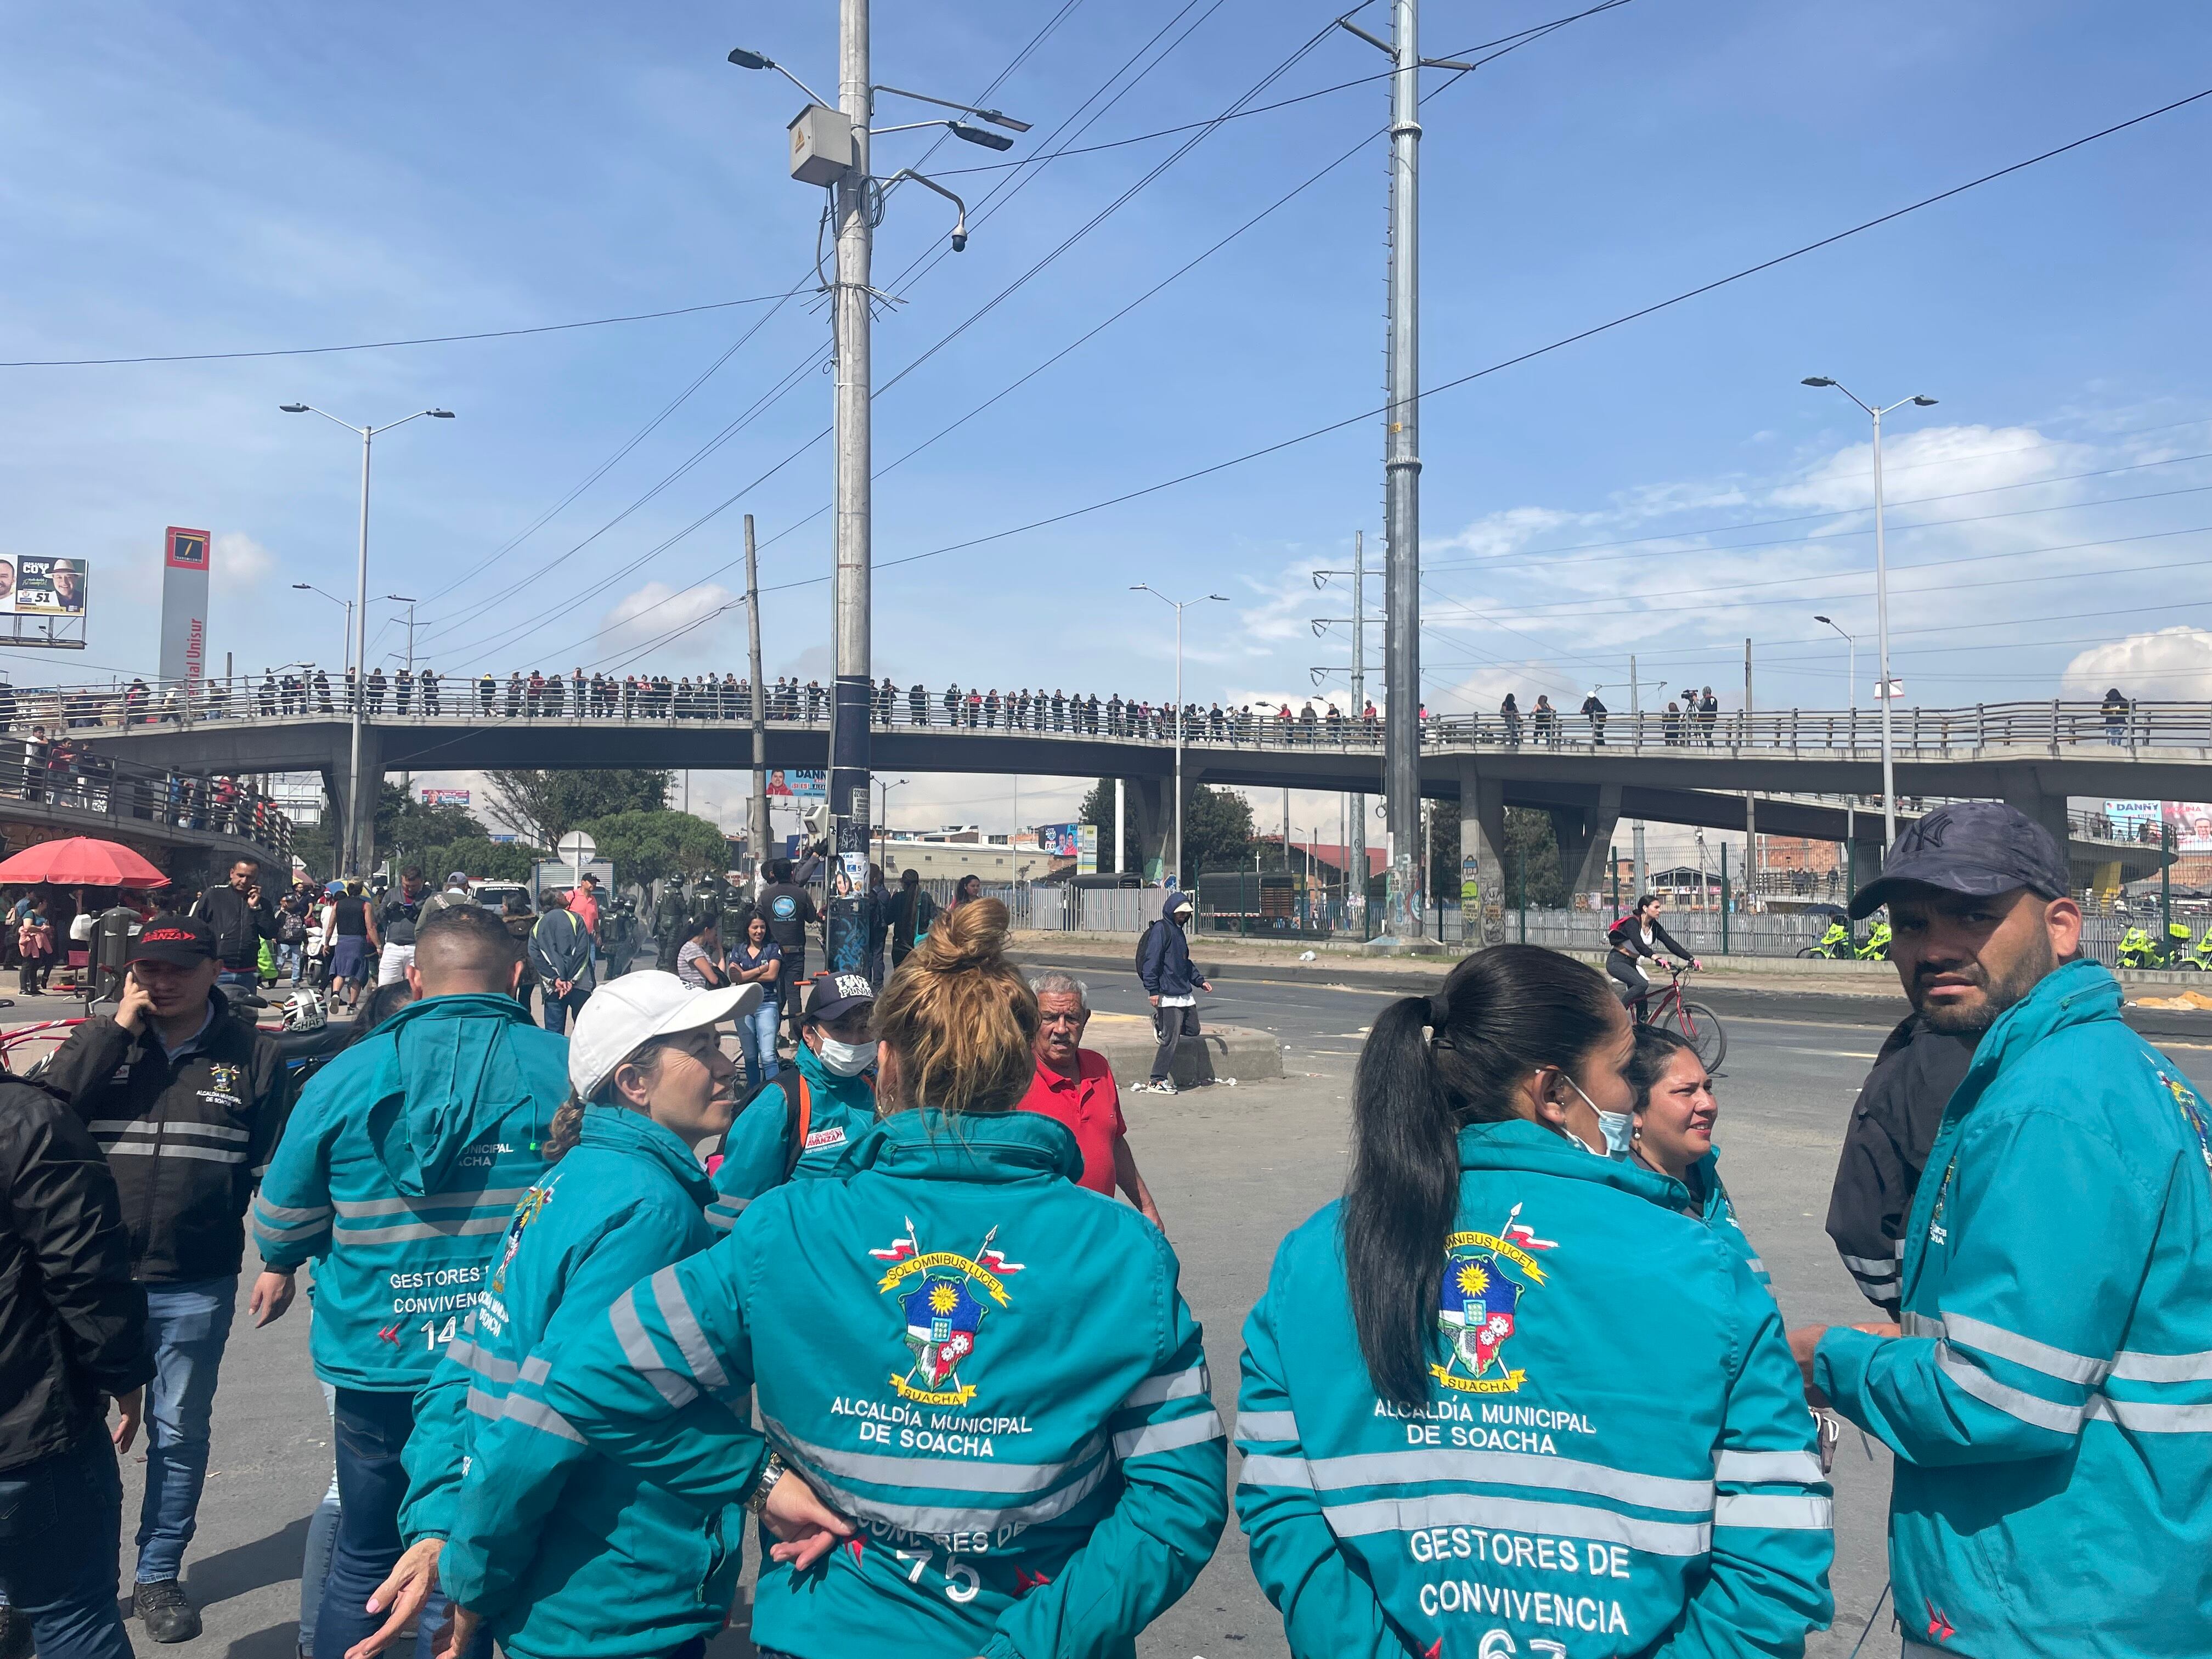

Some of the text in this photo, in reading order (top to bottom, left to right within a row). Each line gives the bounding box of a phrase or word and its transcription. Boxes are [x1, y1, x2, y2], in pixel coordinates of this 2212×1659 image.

[22, 565, 49, 574] COY
[35, 592, 50, 603] 51
[187, 618, 202, 658] Unisur
[795, 769, 826, 779] DANN
[2117, 803, 2159, 811] DANNY
[840, 986, 874, 998] PINK
[293, 1017, 325, 1030] SHAFT
[1444, 1233, 1535, 1268] MNIBUS LUCET
[390, 1267, 480, 1289] GESTORES
[887, 1254, 1002, 1293] SOL OMNIBUS LUCET
[904, 1388, 961, 1404] SUACHA
[1447, 1378, 1511, 1393] SUACHA
[831, 1396, 1032, 1435] ALCALDÍA MUNICIPAL
[1374, 1395, 1596, 1434] ALCALDÍA MUNICIPAL
[859, 1421, 995, 1457] DE SOACHA
[1407, 1424, 1557, 1455] DE SOACHA
[1410, 1527, 1631, 1579] GESTORES DE
[896, 1549, 980, 1603] 75
[1420, 1580, 1629, 1636] CONVIVENCIA
